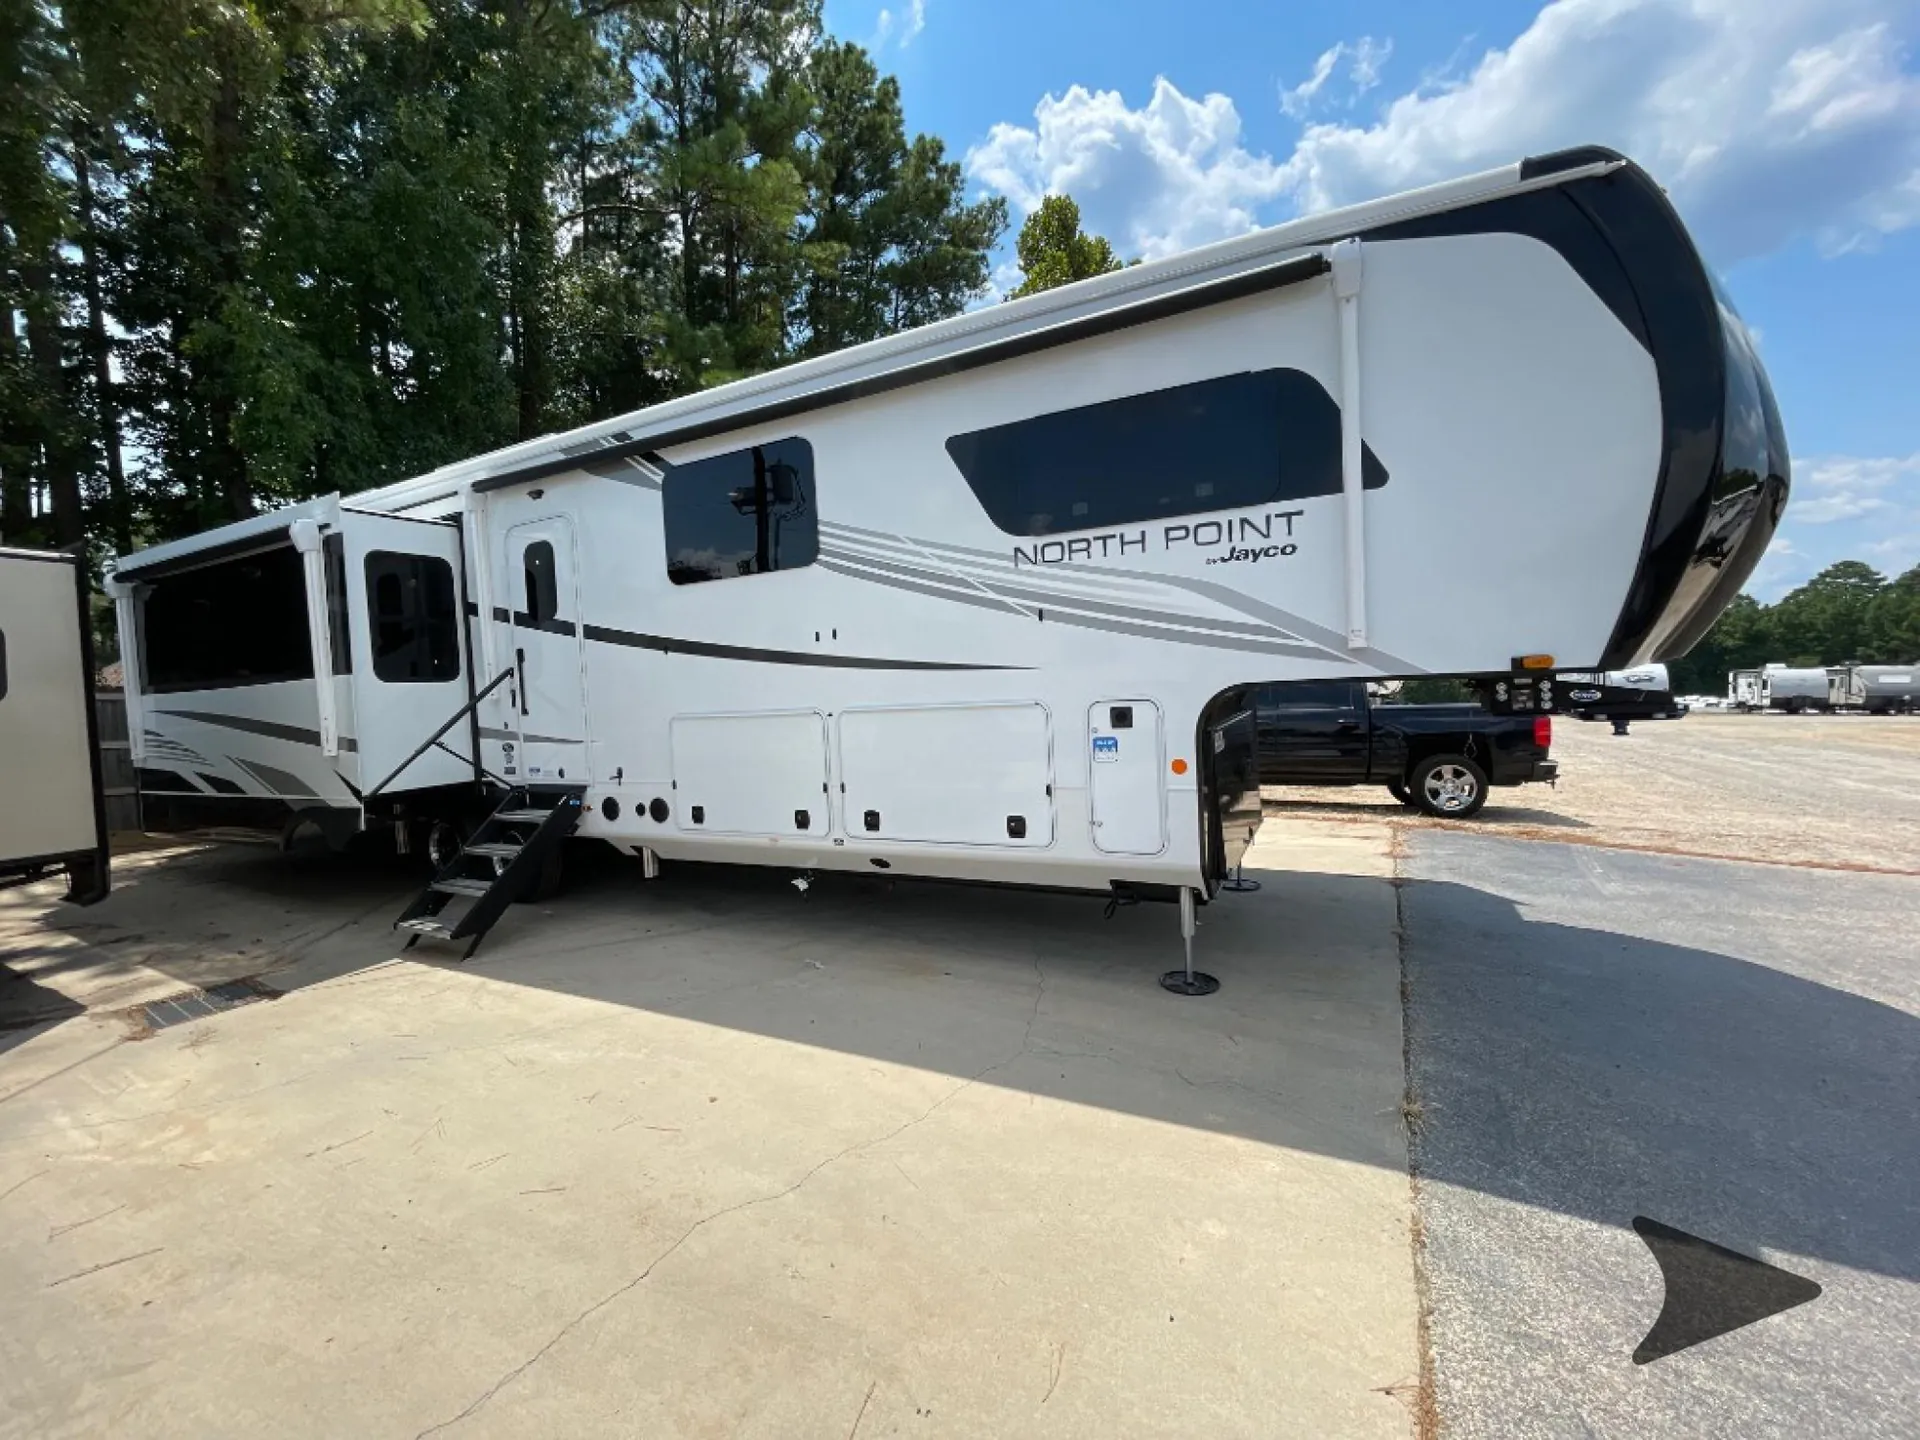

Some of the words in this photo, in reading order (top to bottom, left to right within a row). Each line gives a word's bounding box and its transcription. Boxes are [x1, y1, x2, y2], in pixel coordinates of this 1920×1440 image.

[1013, 530, 1146, 567] NORTH
[1164, 509, 1305, 550] POINT
[1219, 544, 1299, 563] Jayco
